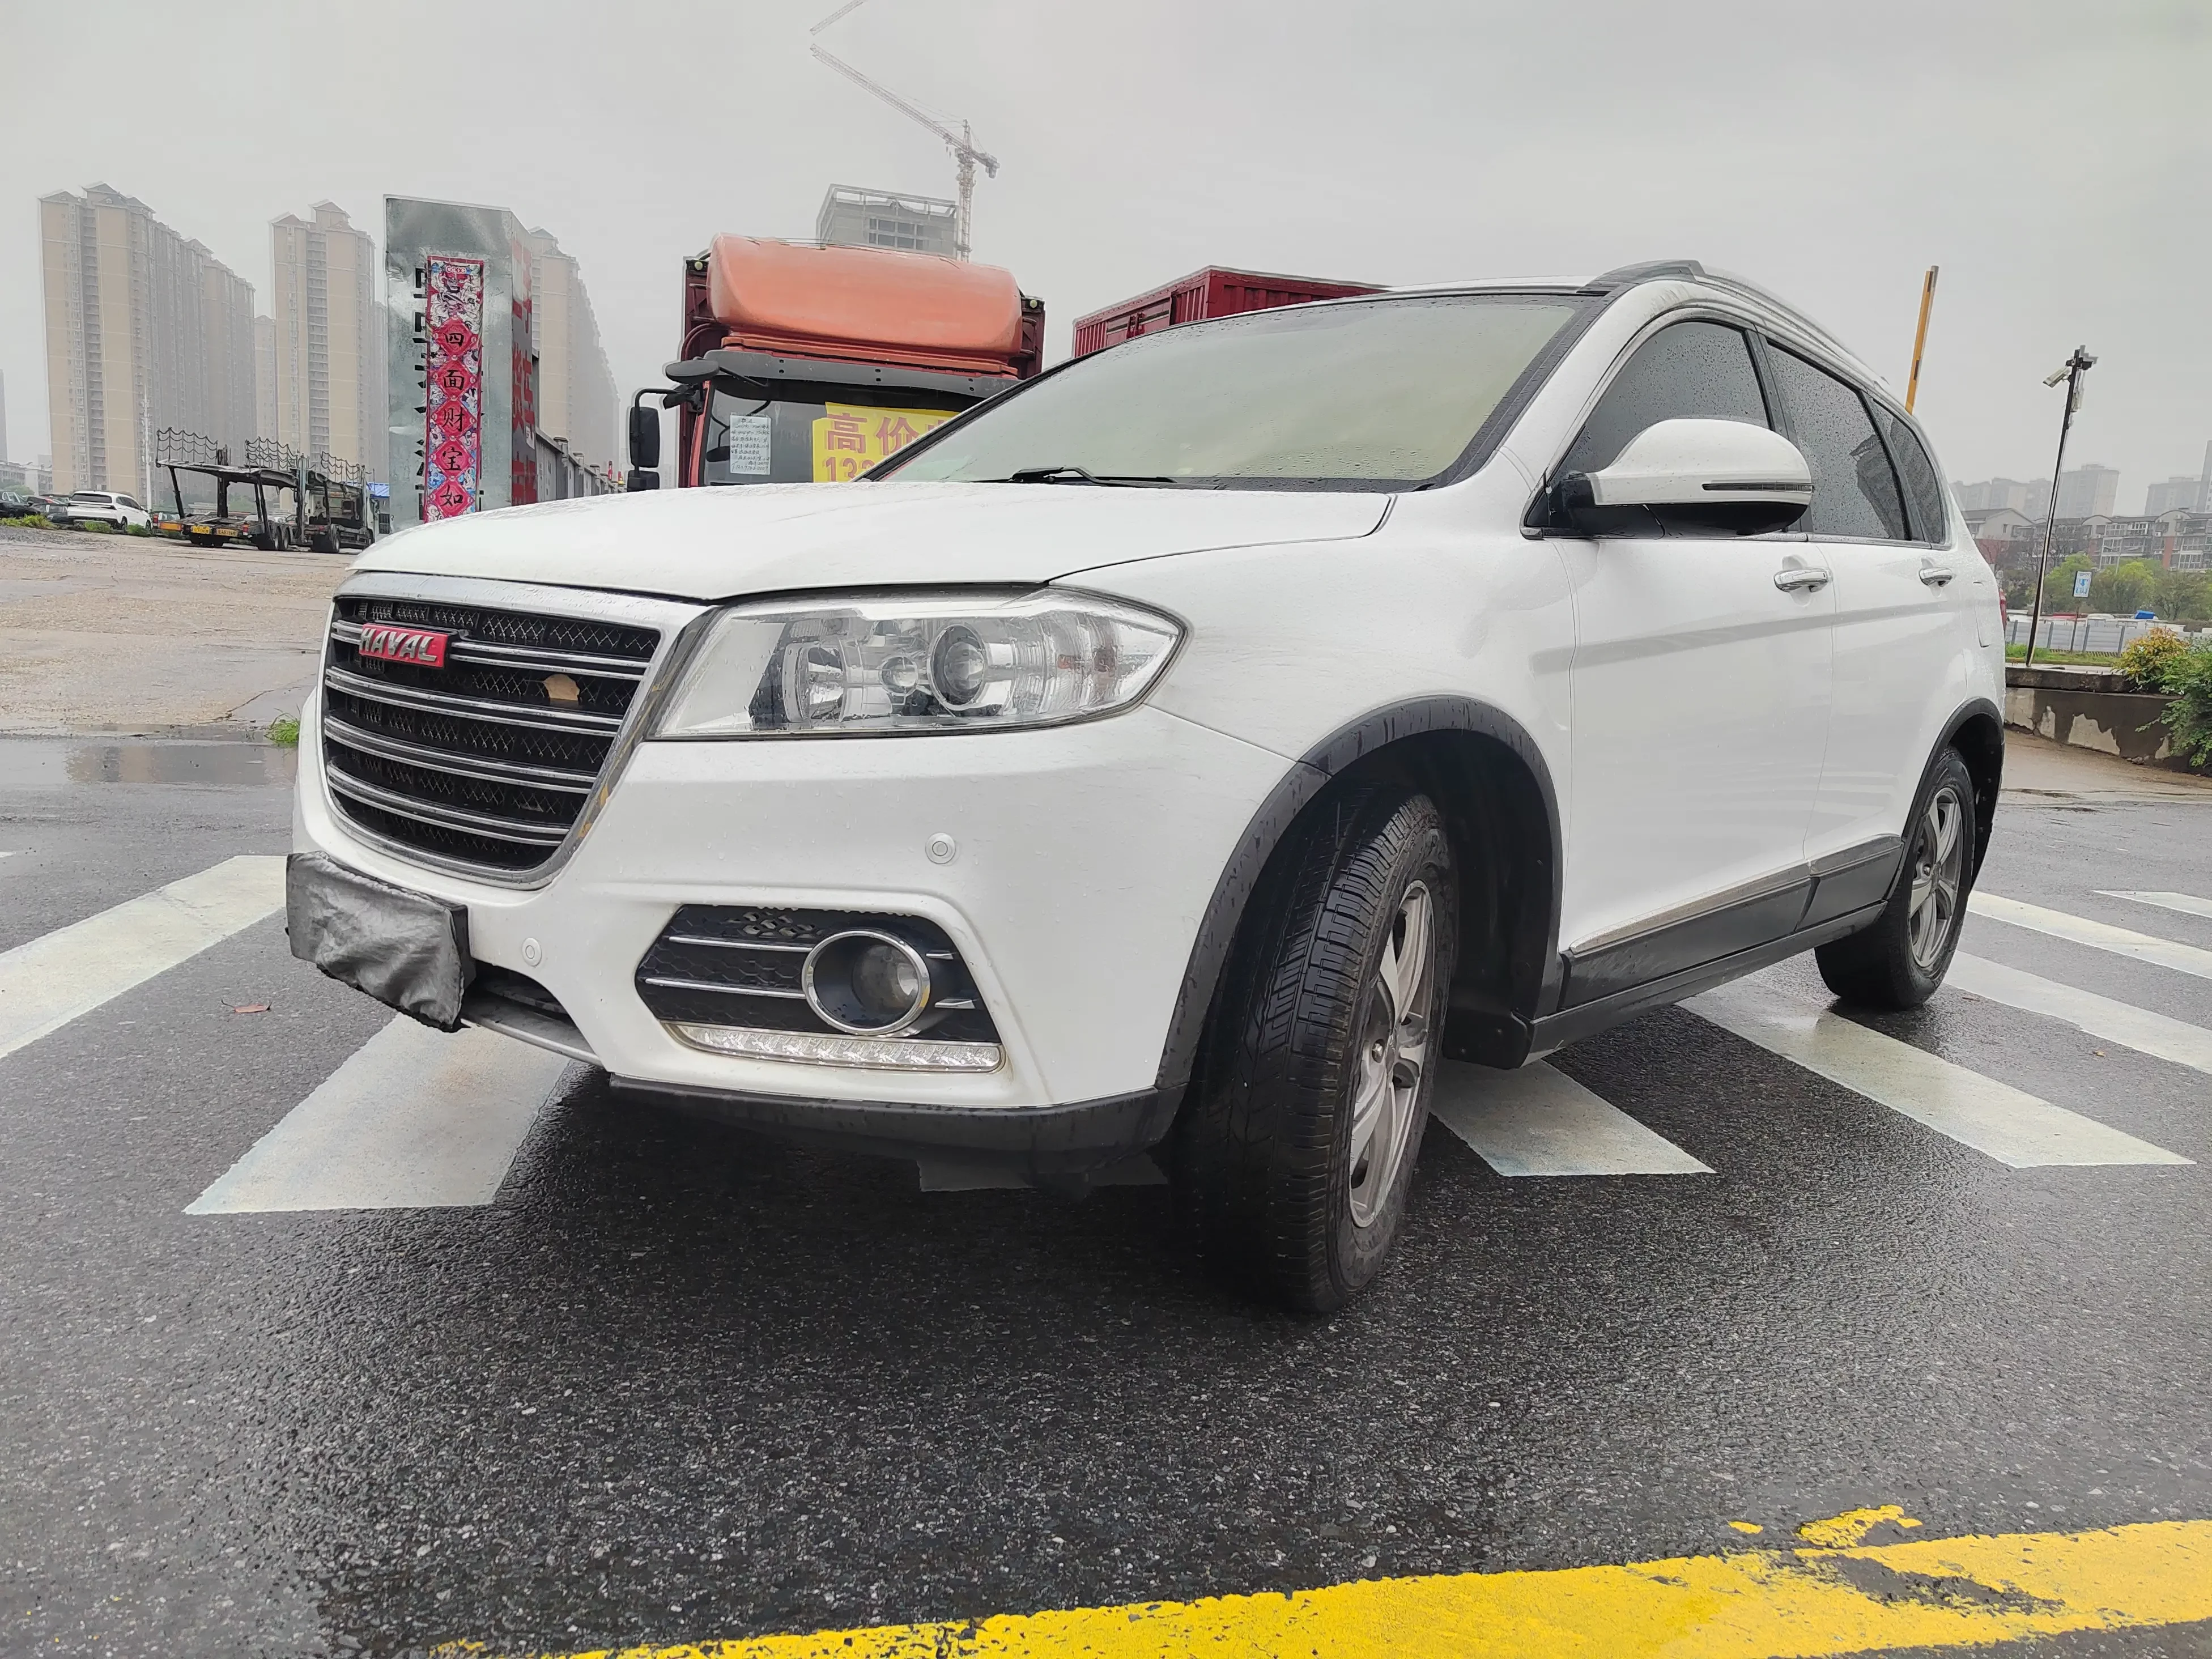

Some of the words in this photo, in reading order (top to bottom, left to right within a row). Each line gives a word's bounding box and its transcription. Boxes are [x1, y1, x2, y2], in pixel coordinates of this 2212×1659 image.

[440, 333, 465, 507] 四面财宝如
[827, 412, 945, 456] 高价
[360, 628, 437, 662] HAVAL
